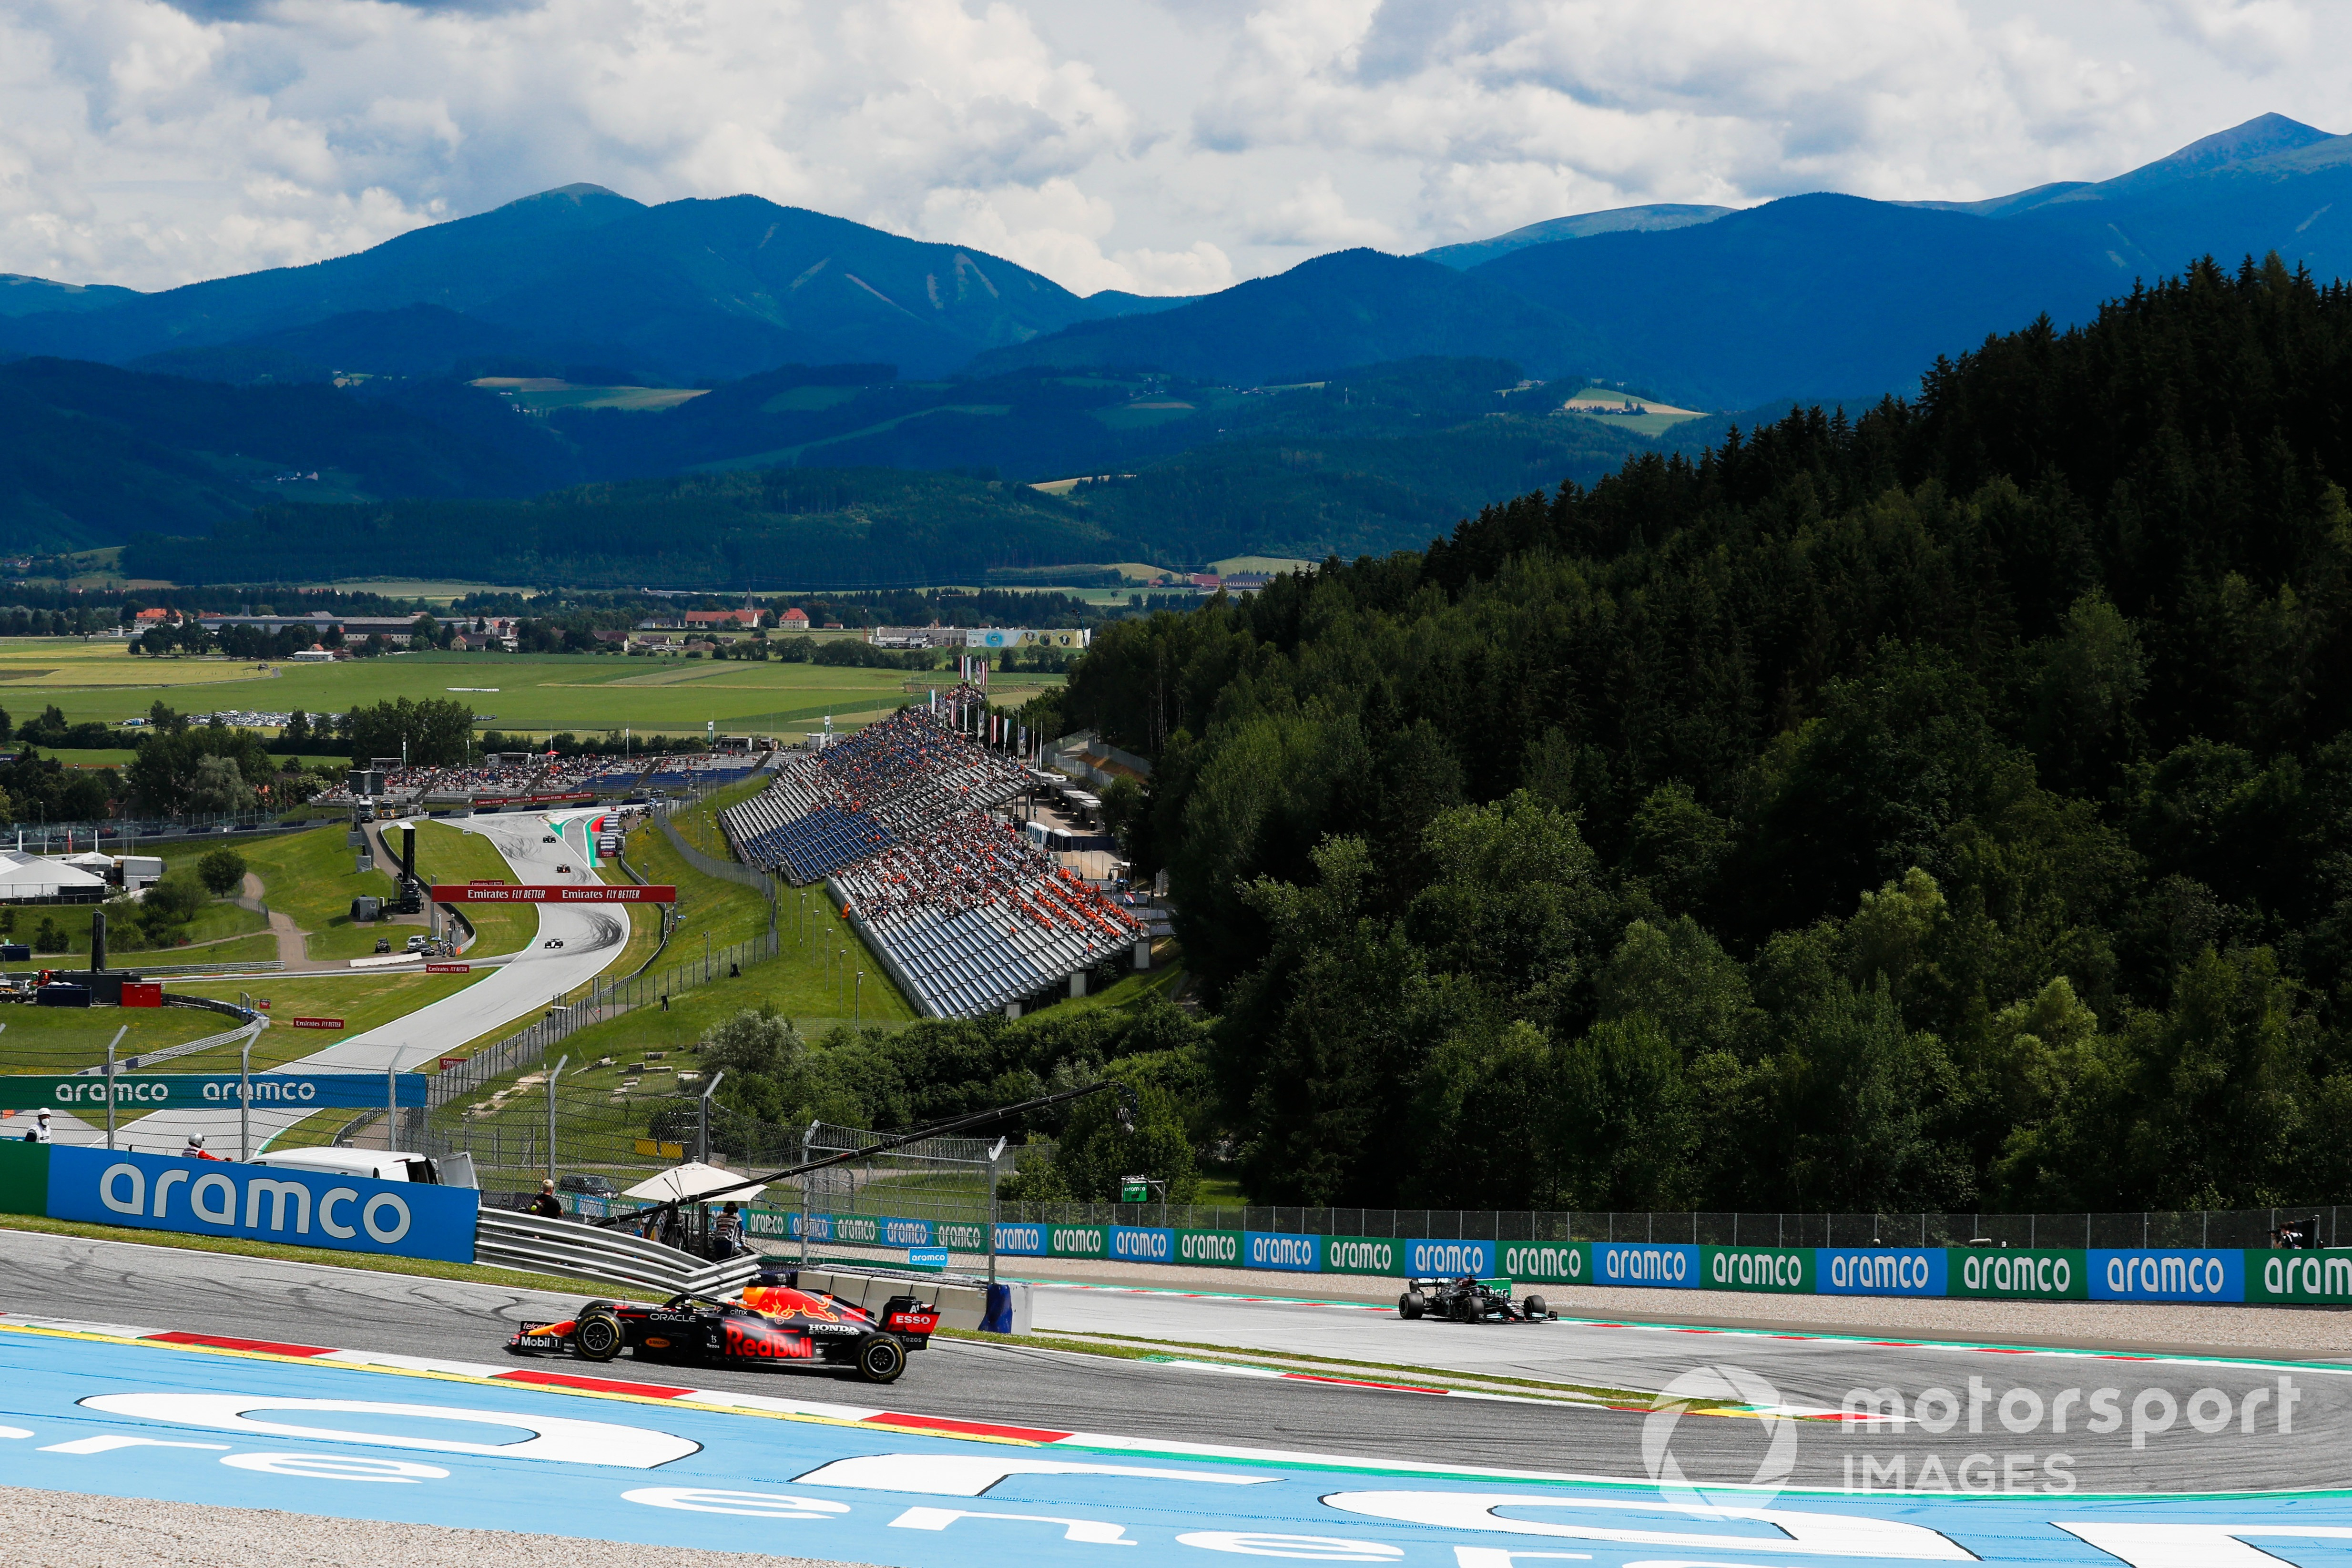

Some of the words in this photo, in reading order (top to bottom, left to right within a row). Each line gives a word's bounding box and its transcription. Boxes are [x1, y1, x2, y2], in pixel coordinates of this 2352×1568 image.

[468, 889, 509, 899] Emirates
[512, 890, 522, 899] FLY
[524, 890, 545, 899] BETTER
[562, 889, 603, 899] Emirates
[606, 890, 617, 899] FLY
[618, 890, 640, 899] BETTER
[55, 1083, 168, 1102] aramco
[203, 1082, 316, 1101] aramco
[100, 1163, 411, 1243] aramco
[838, 1218, 875, 1241] aramco
[887, 1222, 927, 1244] aramco
[938, 1225, 980, 1248] aramco
[995, 1228, 1039, 1250] aramco
[1054, 1230, 1101, 1252] aramco
[1116, 1232, 1166, 1257] aramco
[1182, 1234, 1236, 1261] aramco
[1253, 1237, 1312, 1265] aramco
[1330, 1242, 1392, 1270] aramco
[911, 1253, 945, 1262] aramco
[1415, 1245, 1483, 1273] aramco
[1506, 1247, 1581, 1277] aramco
[1607, 1250, 1686, 1281] aramco
[1713, 1252, 1802, 1286] aramco
[1832, 1256, 1928, 1288] aramco
[1964, 1256, 2070, 1292] aramco
[2107, 1257, 2224, 1293] aramco
[650, 1313, 696, 1323] ORACLE
[808, 1324, 859, 1333] HONDA
[896, 1315, 931, 1324] ESSO
[521, 1336, 550, 1347] Mobil
[554, 1339, 559, 1347] 1
